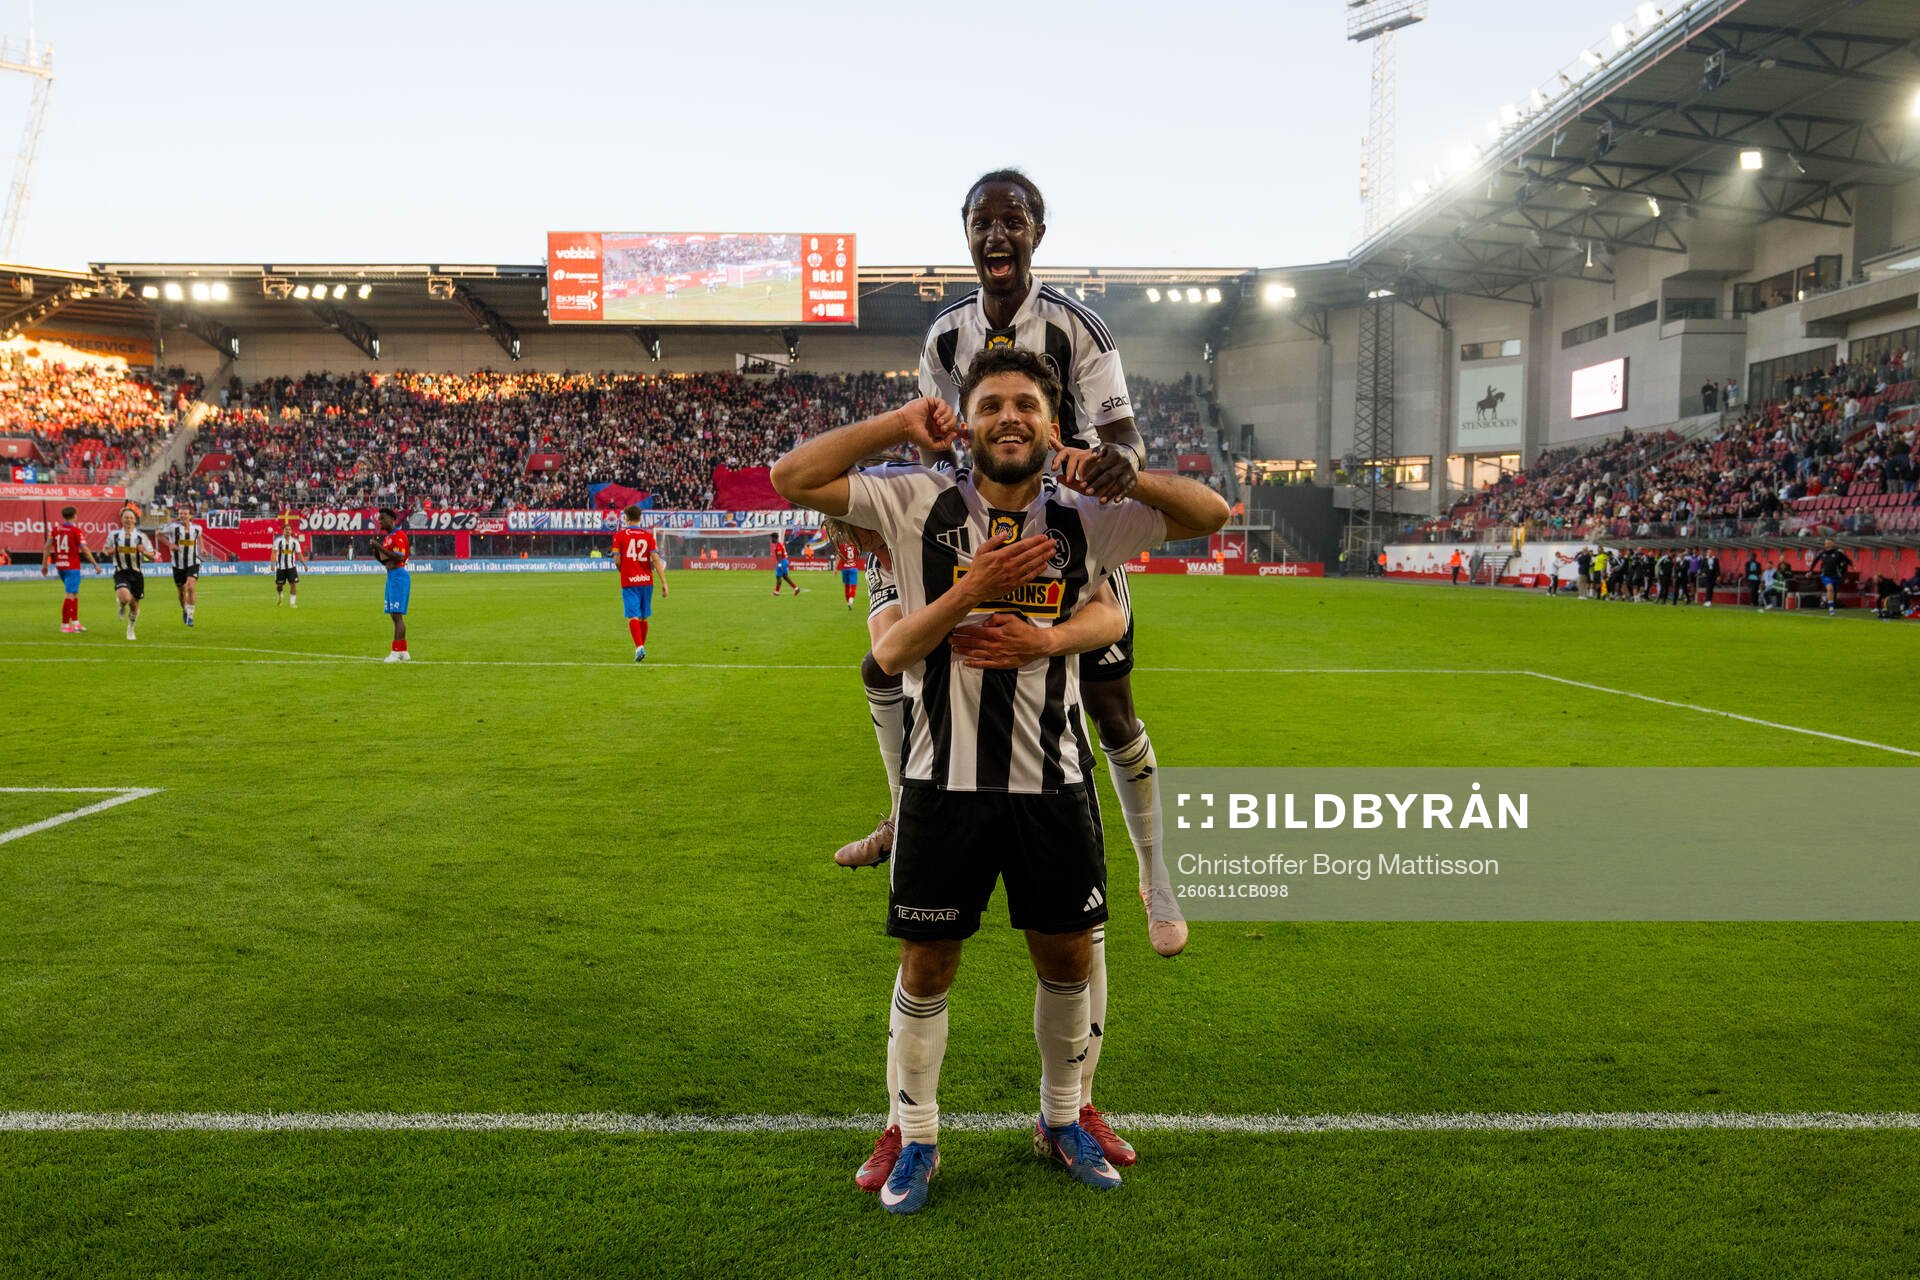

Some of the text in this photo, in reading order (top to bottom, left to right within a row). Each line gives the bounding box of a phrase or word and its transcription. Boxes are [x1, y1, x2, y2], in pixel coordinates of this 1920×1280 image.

[837, 238, 844, 251] 2
[555, 246, 596, 259] vobbiz
[1461, 418, 1519, 430] STENBOCKEN
[56, 534, 69, 553] 14
[626, 538, 648, 562] 42
[450, 563, 481, 572] Logistik
[731, 562, 757, 570] group
[1187, 562, 1225, 573] WANS
